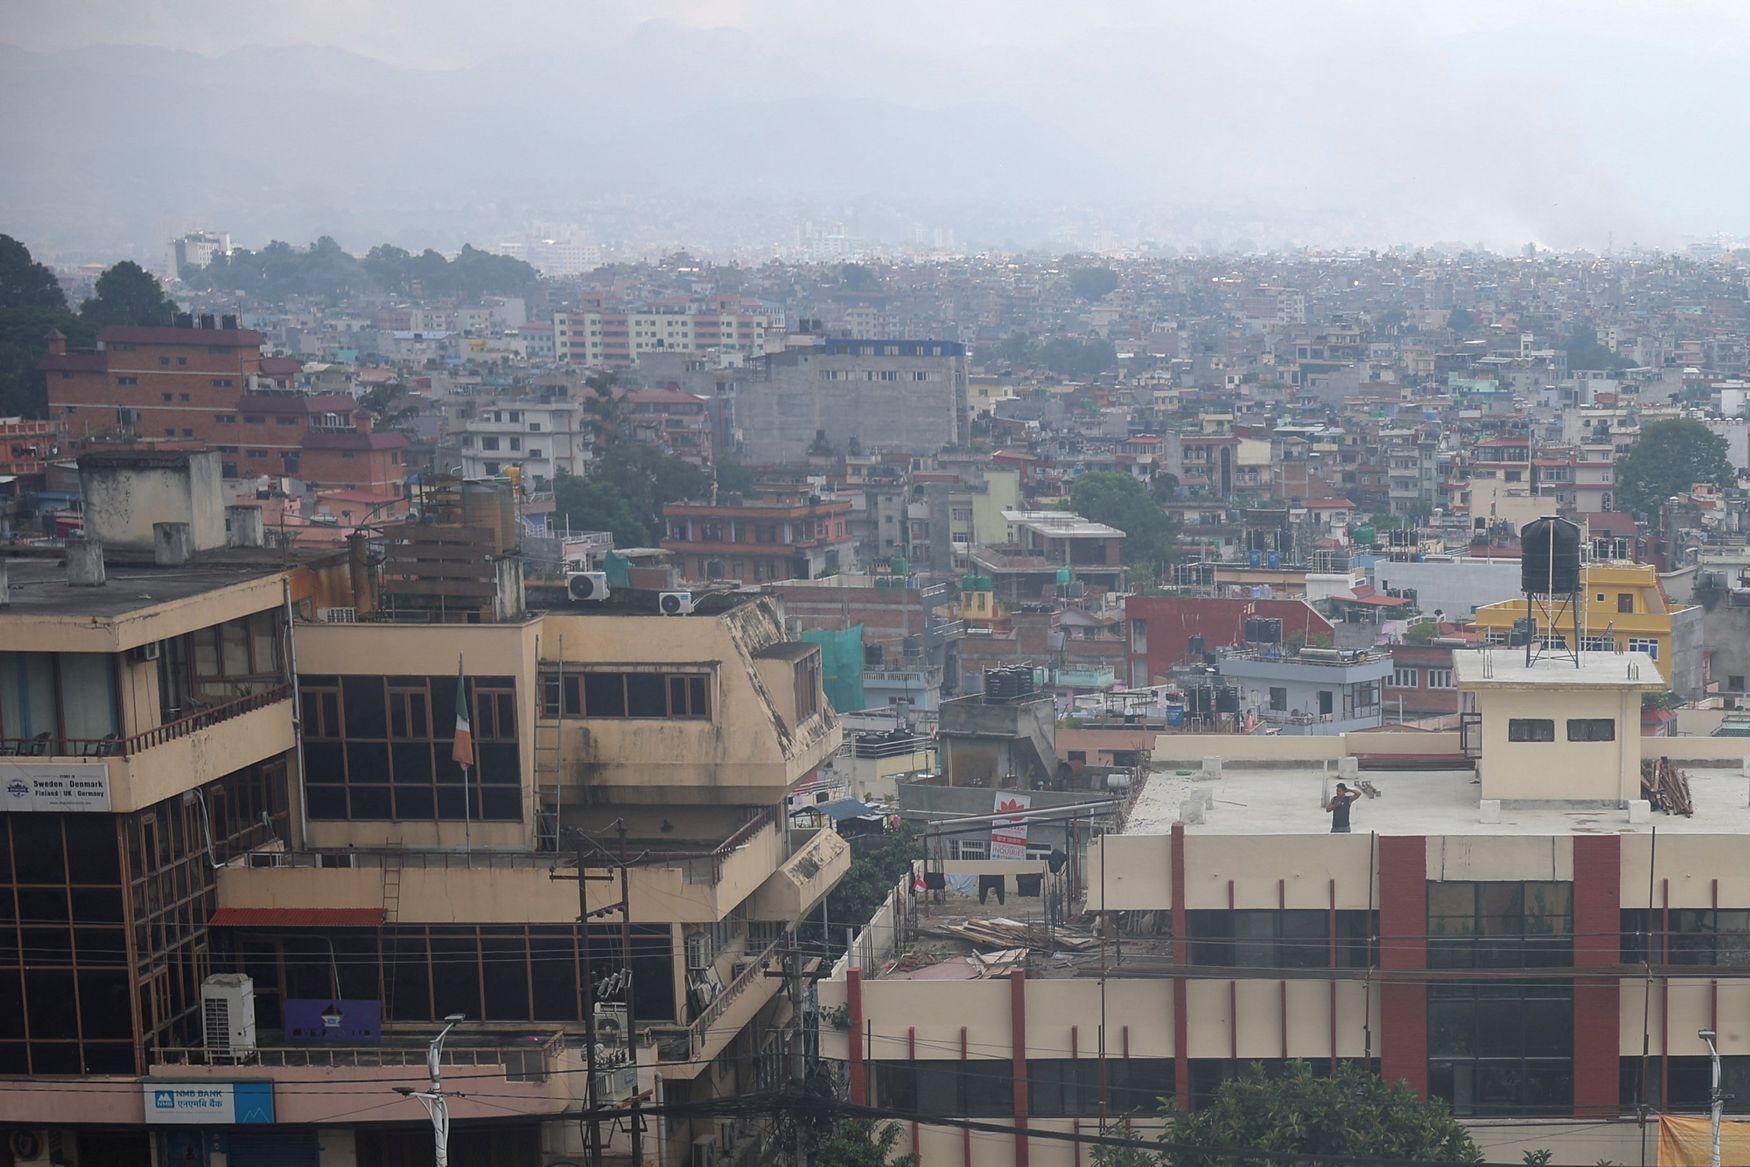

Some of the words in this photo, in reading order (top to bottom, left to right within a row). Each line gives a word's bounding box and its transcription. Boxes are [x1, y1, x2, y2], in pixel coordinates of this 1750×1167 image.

[33, 780, 63, 788] Sweden
[69, 780, 103, 788] Denmark
[77, 790, 104, 798] Germany
